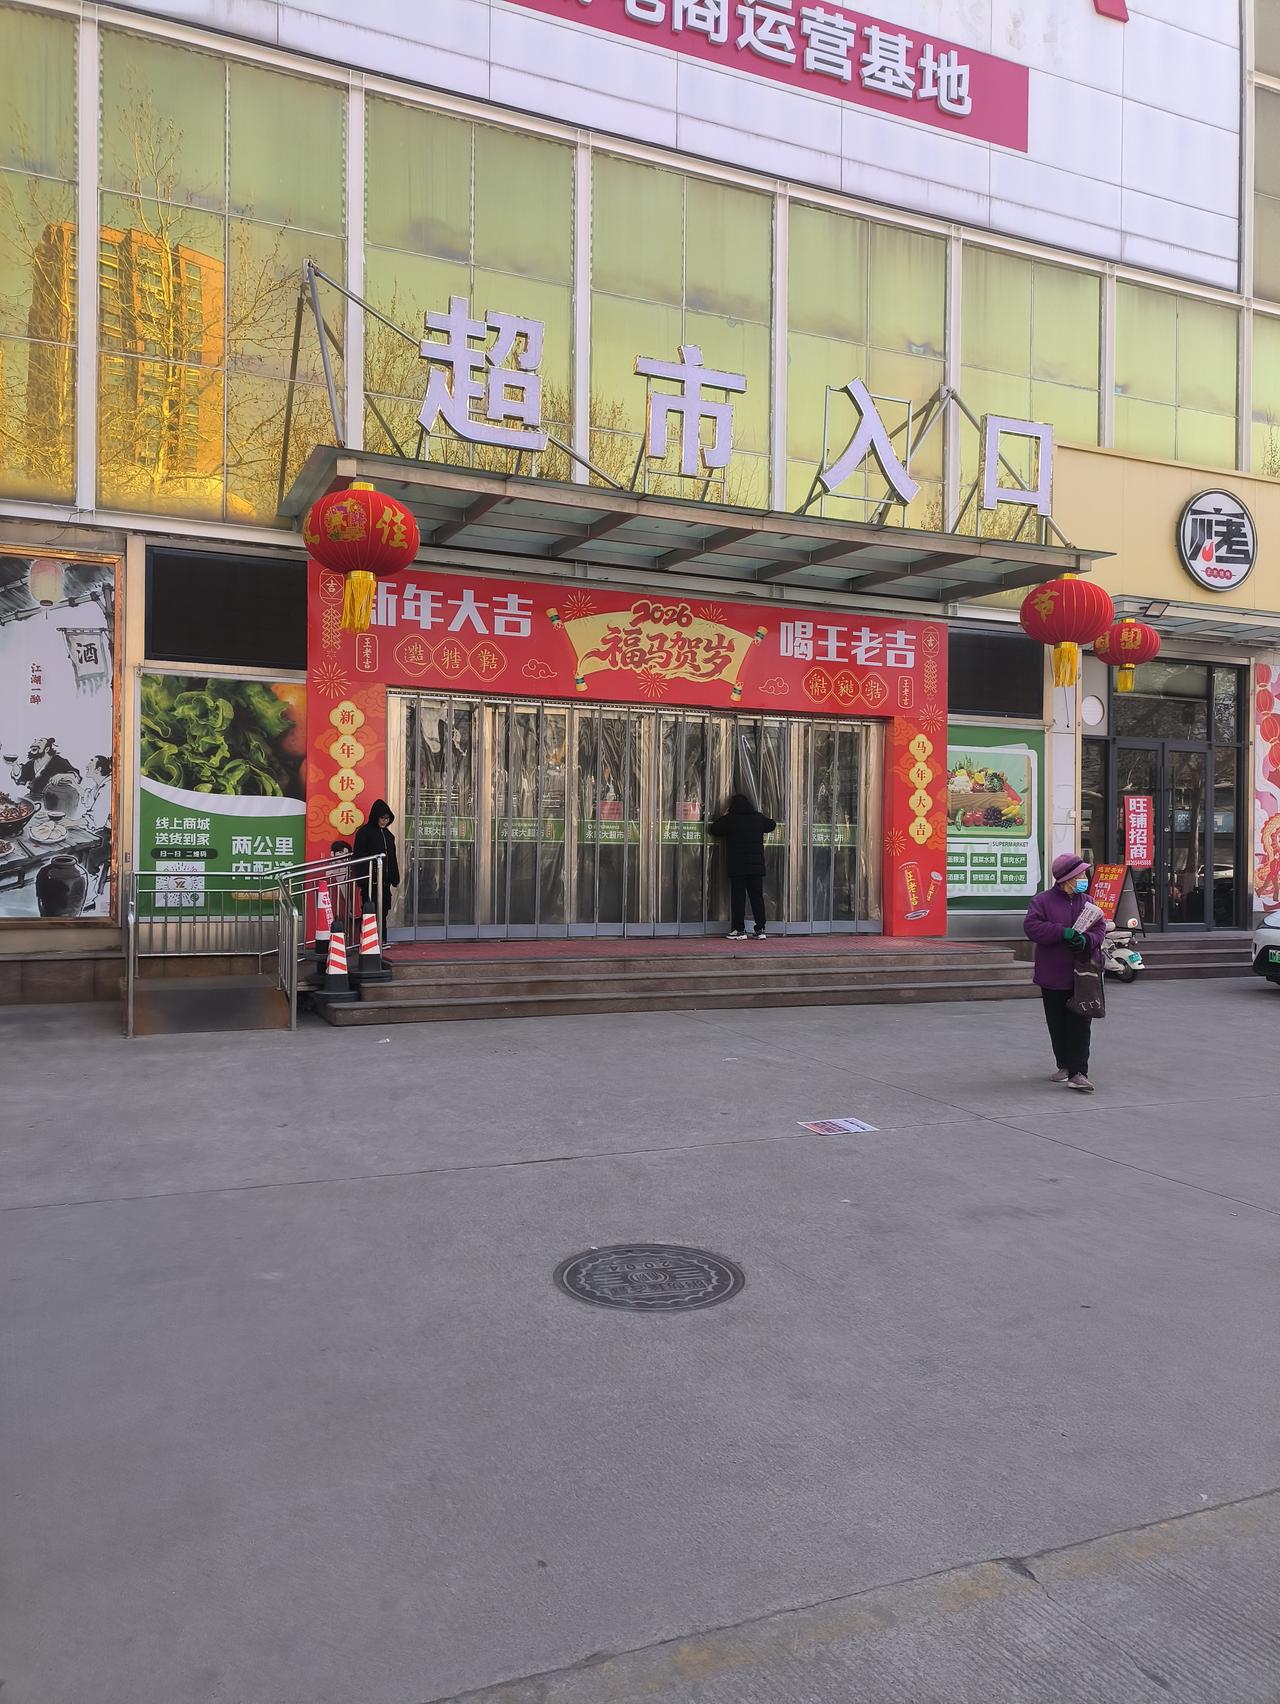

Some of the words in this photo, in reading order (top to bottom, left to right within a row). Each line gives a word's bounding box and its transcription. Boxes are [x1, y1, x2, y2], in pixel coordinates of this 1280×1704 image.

[418, 296, 1053, 517] 超市入口
[629, 601, 693, 628] 2026
[76, 642, 99, 665] 酒
[363, 637, 373, 670] 王老吉
[585, 624, 736, 678] 福马贺岁
[780, 621, 917, 669] 喝王老吉
[339, 709, 355, 825] 新年快乐
[915, 741, 927, 837] 马年大吉
[155, 817, 210, 831] 线上商城
[155, 832, 210, 846] 送货到家
[1129, 798, 1148, 859] 旺铺招商
[231, 836, 294, 856] 两公里
